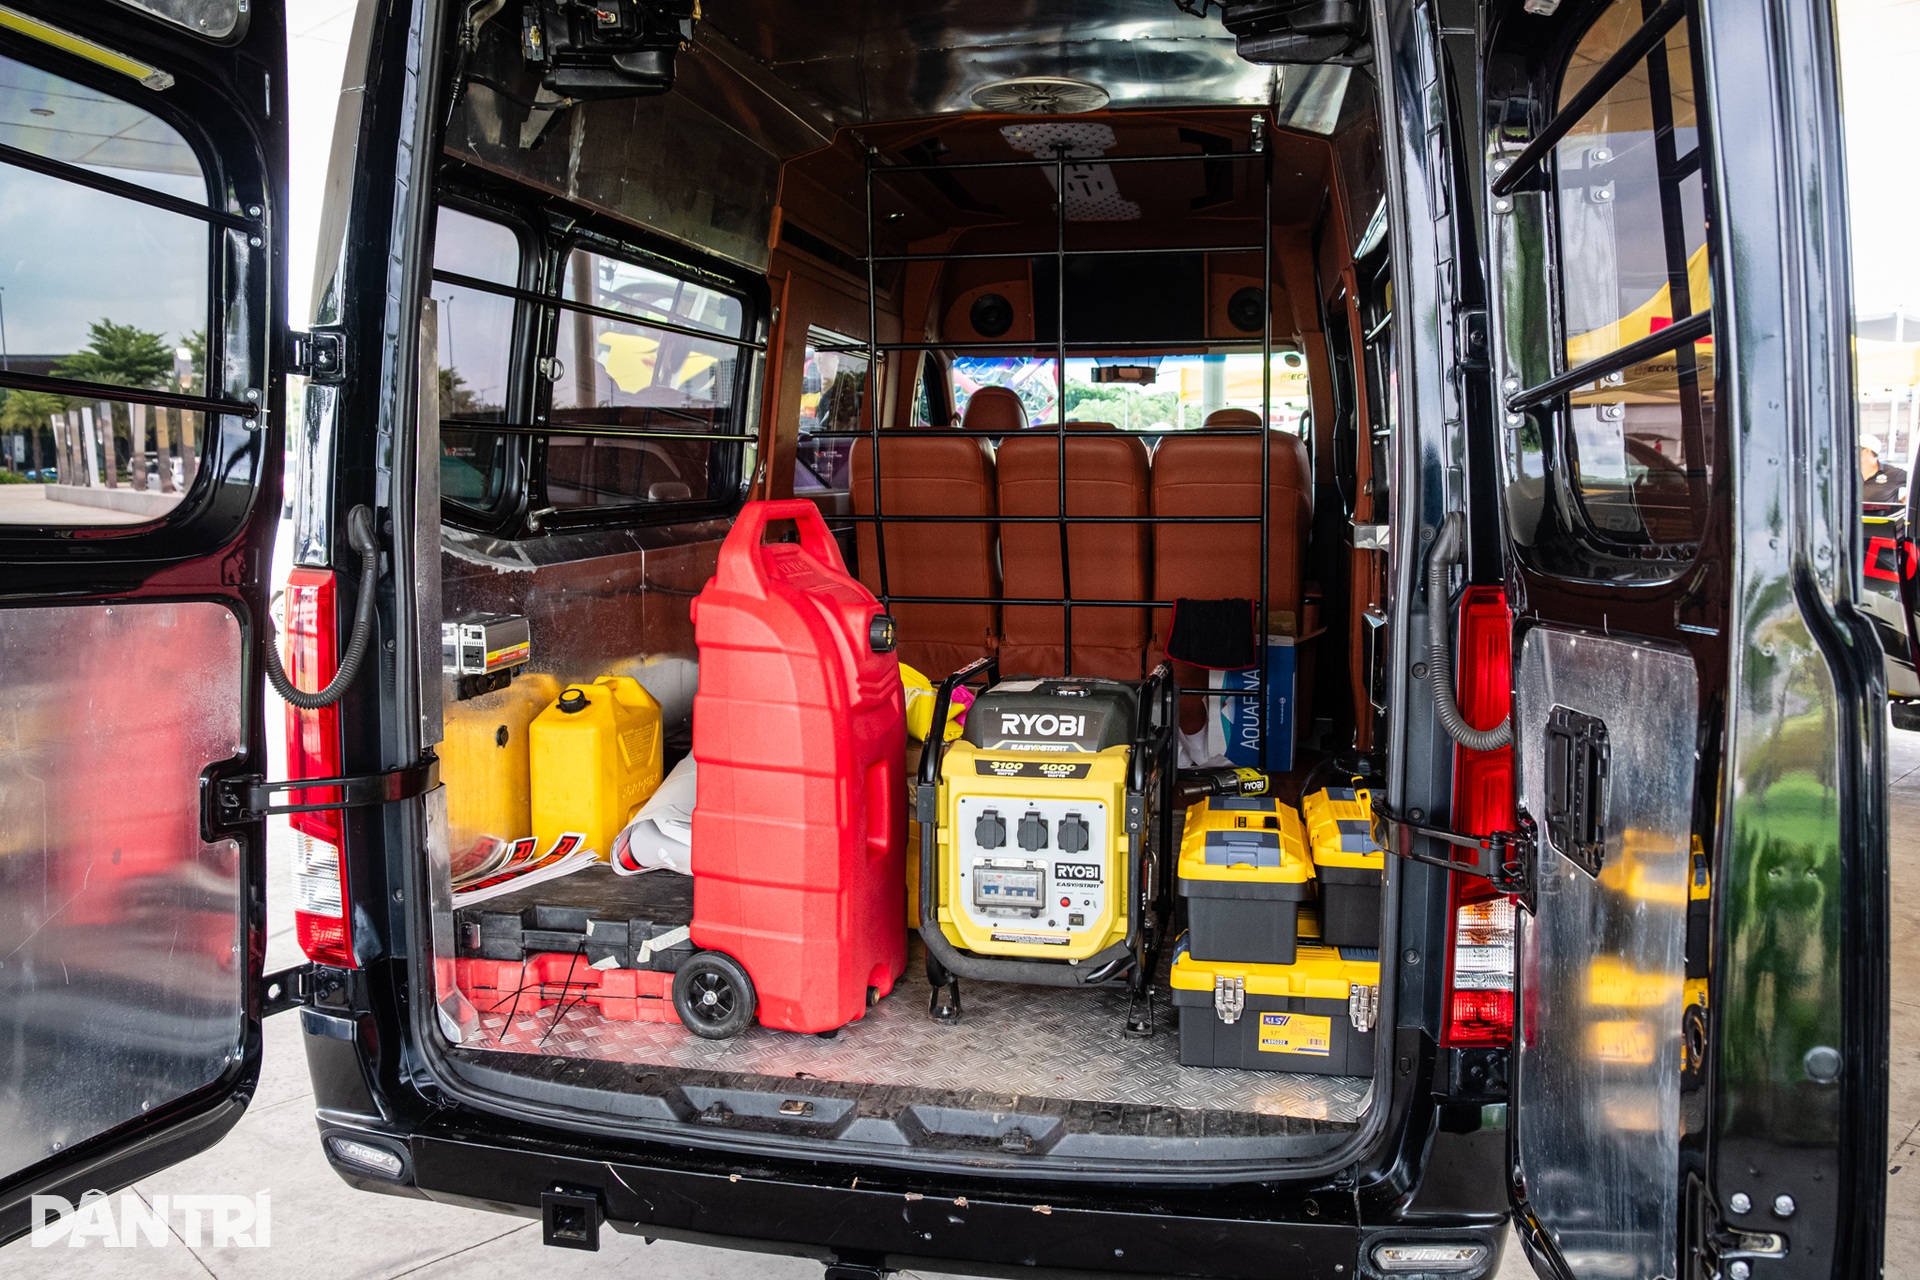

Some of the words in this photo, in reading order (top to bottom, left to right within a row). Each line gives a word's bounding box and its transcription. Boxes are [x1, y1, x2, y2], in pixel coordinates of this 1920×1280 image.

[1240, 669, 1260, 750] AQUAFNA
[1001, 713, 1086, 737] RYOBI
[990, 762, 1024, 770] 3100
[1244, 780, 1264, 791] RYOBI
[1057, 864, 1099, 879] RYOBI
